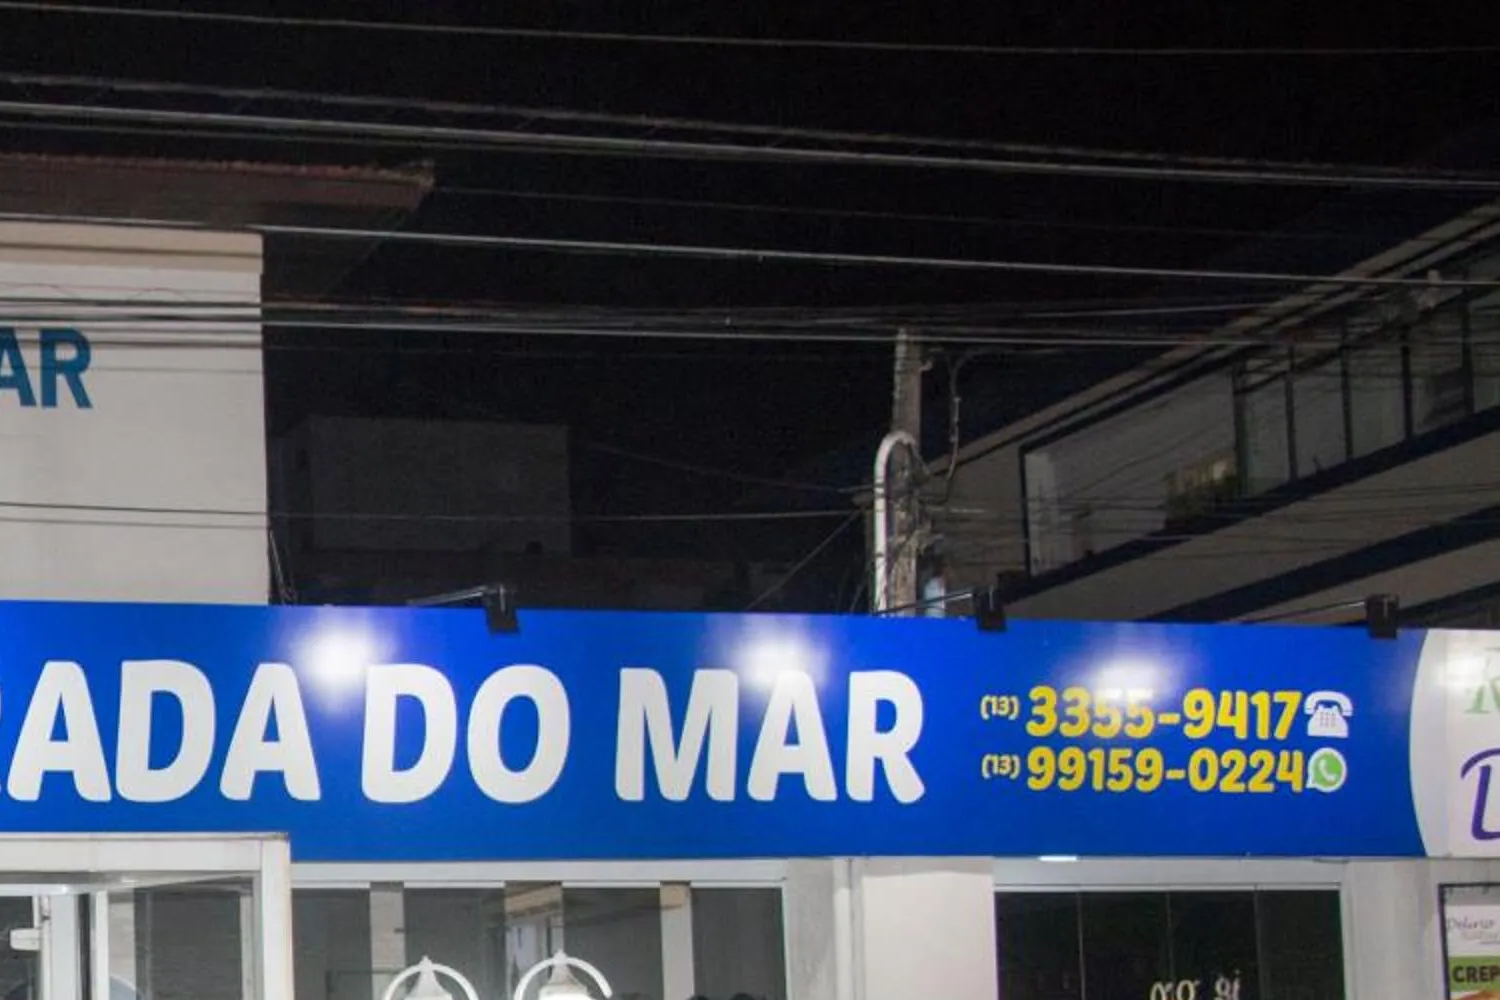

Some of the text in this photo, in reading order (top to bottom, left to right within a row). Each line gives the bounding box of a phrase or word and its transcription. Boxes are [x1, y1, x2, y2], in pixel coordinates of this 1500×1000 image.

[360, 663, 570, 802] DO
[615, 669, 925, 803] MAR
[980, 686, 1301, 738] (13) 3355-9417
[982, 746, 1304, 792] (13) 99159-0224
